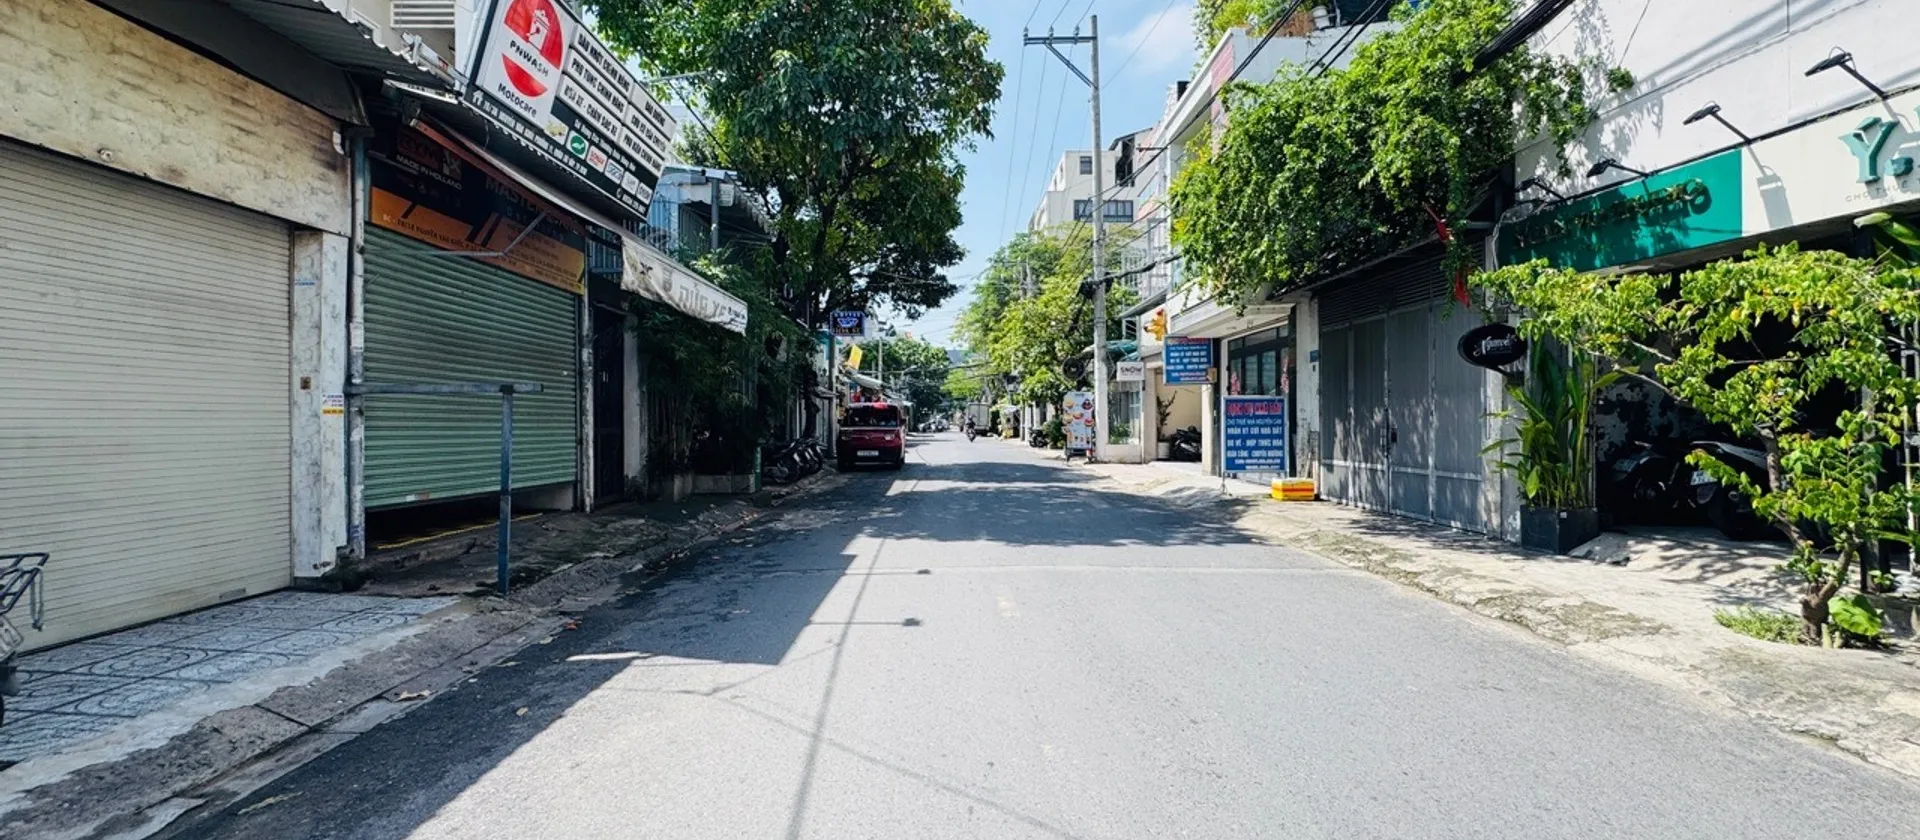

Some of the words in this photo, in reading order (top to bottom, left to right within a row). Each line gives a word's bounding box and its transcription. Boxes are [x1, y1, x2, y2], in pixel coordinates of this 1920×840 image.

[509, 39, 549, 77] PNWASH
[497, 82, 537, 119] Motocare
[396, 154, 420, 171] MADE
[429, 169, 463, 190] HOLLAND
[1120, 366, 1142, 374] SNOW
